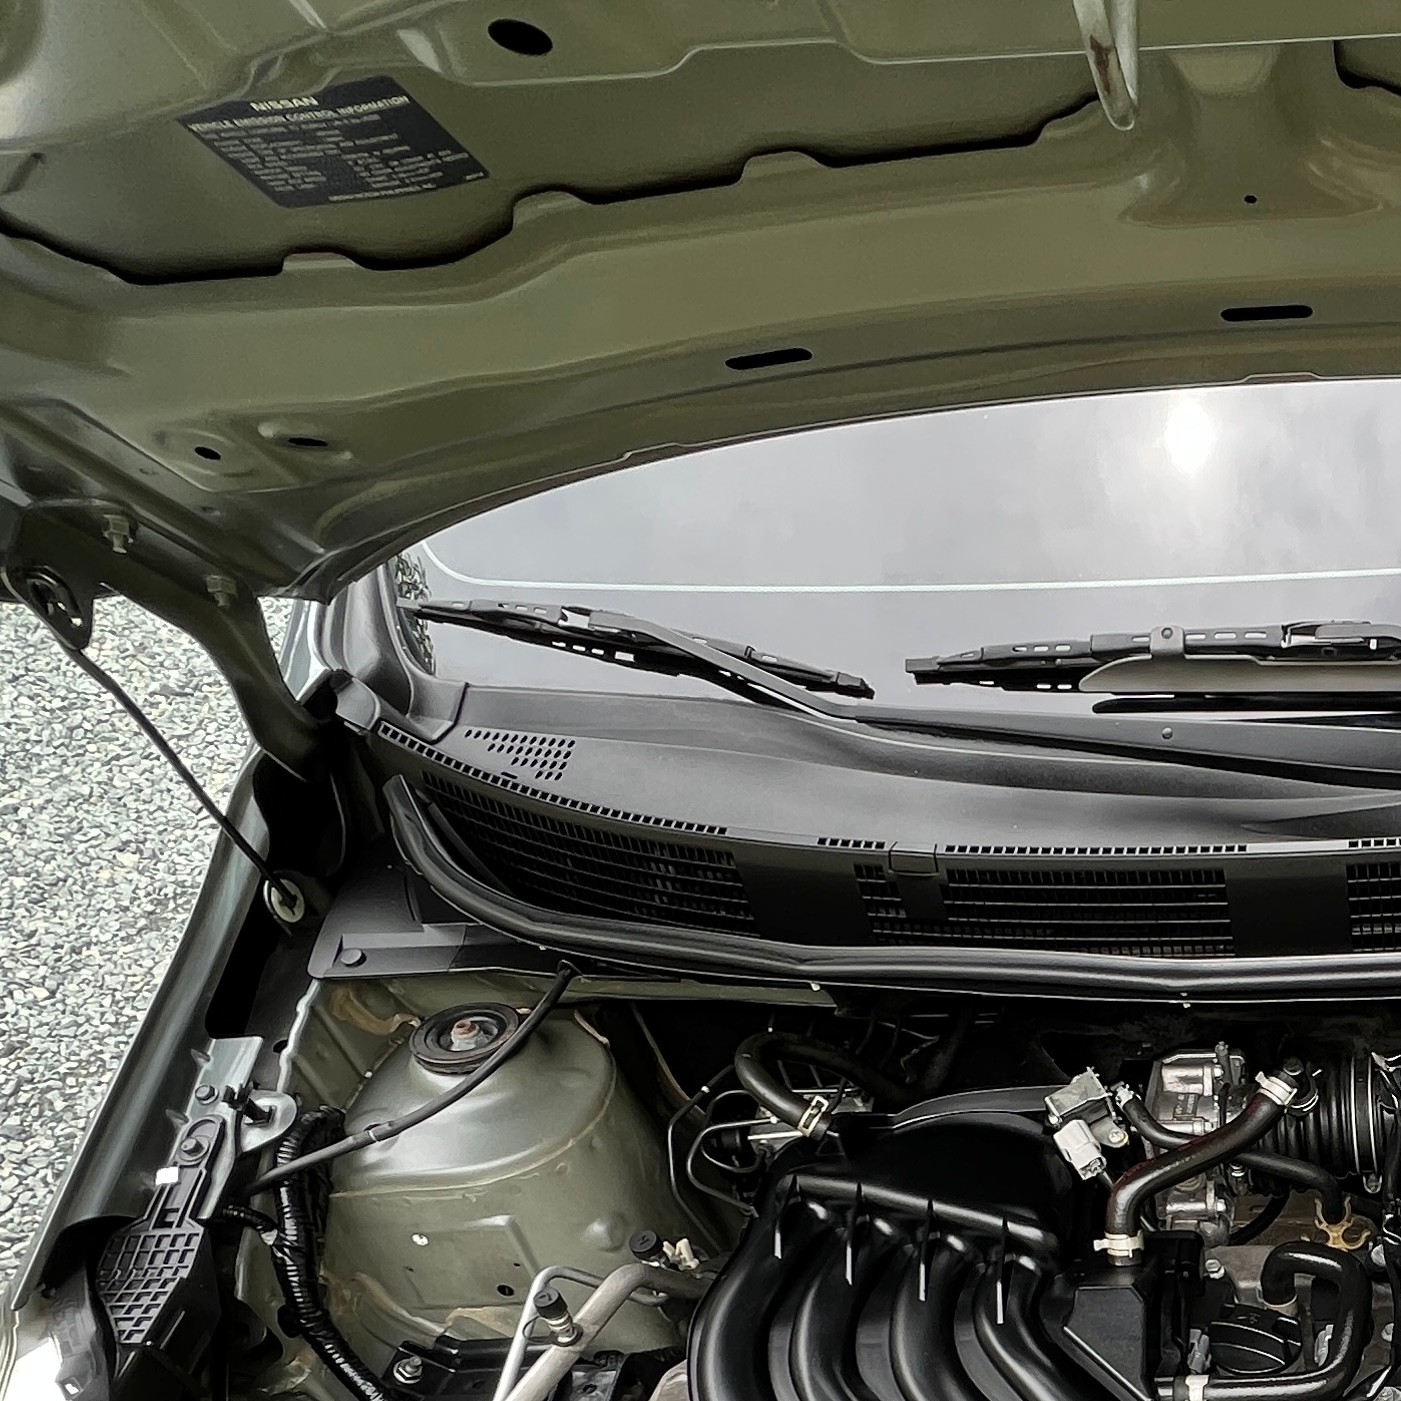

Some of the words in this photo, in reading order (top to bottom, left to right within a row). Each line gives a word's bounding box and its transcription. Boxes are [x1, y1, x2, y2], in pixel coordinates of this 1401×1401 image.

[250, 96, 319, 112] NISSAN
[285, 108, 337, 123] CONTROL
[336, 95, 411, 117] INFORMATION
